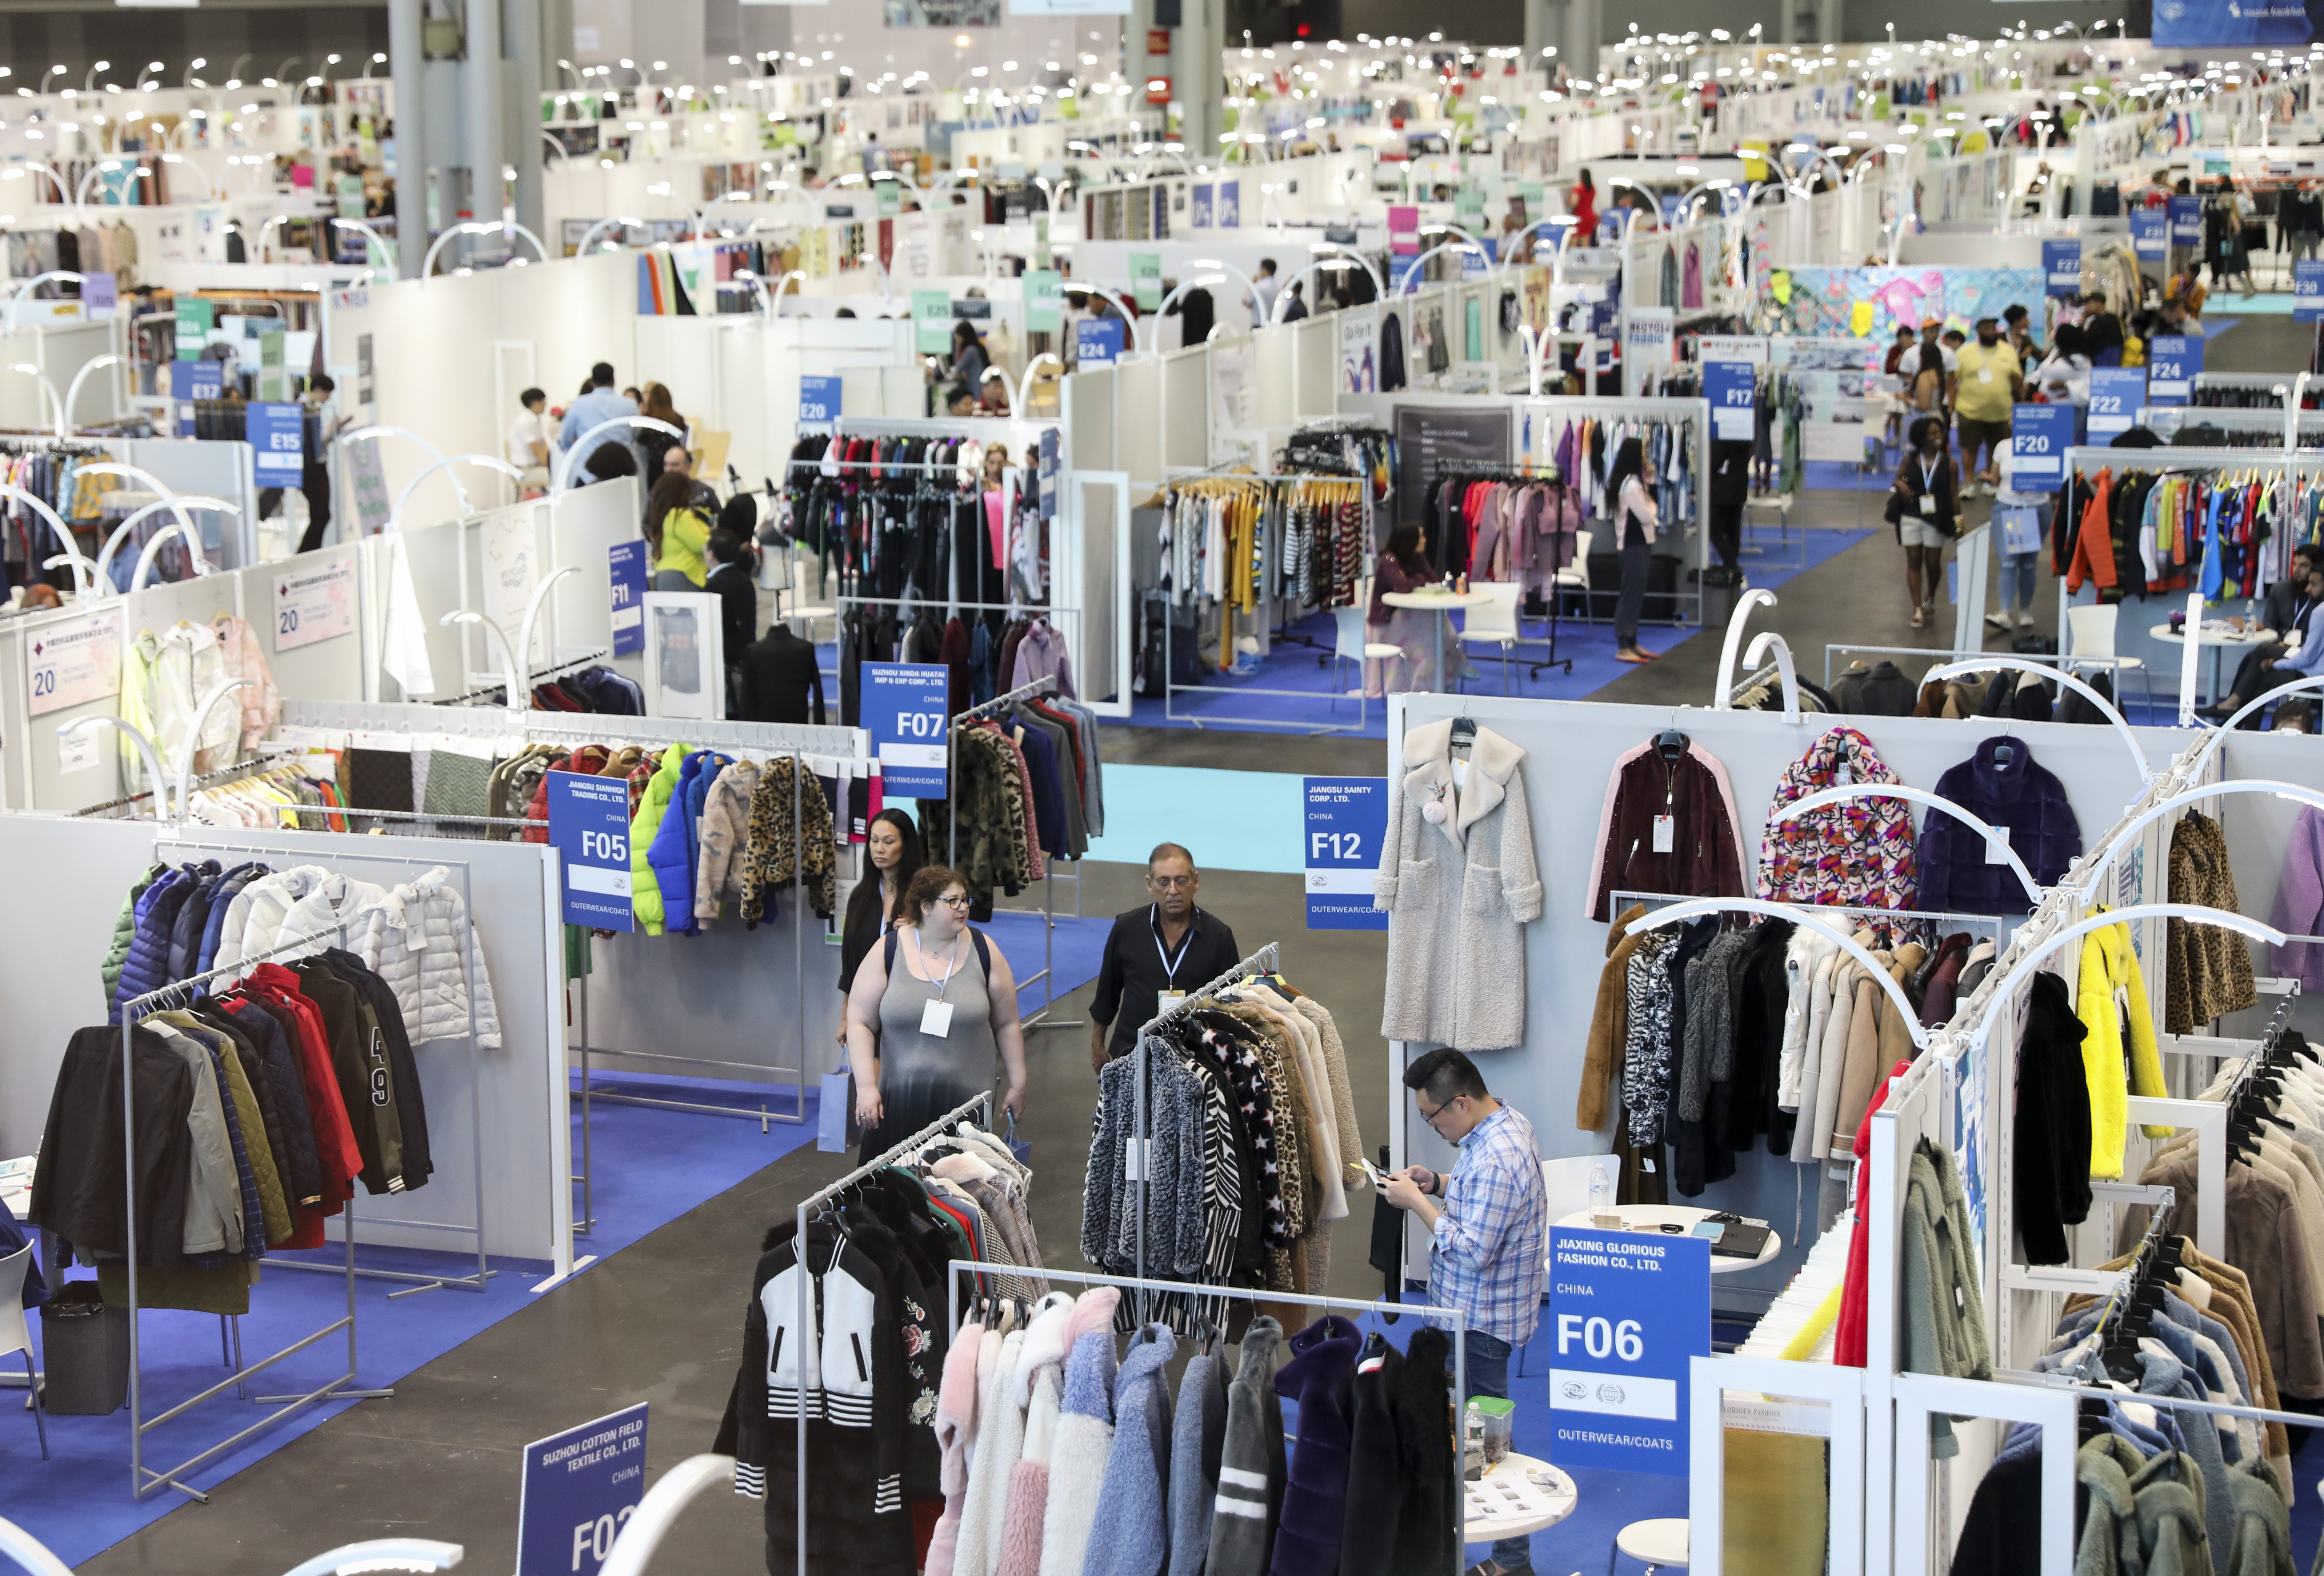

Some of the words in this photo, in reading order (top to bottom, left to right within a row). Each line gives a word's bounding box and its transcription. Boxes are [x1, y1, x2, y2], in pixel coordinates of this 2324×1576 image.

[2244, 8, 2269, 17] messe
[2271, 6, 2306, 17] frankfurt
[332, 291, 369, 308] KOREA
[1079, 343, 1105, 357] E24
[2152, 362, 2181, 379] F24
[192, 383, 221, 399] E17
[1727, 389, 1752, 405] F17
[800, 403, 826, 419] E20
[2090, 396, 2121, 413] F22
[270, 432, 301, 450] E15
[2015, 435, 2050, 453] F20
[612, 583, 629, 605] F11
[280, 610, 298, 634] 20
[35, 670, 54, 696] 20
[897, 712, 944, 737] F07
[568, 781, 595, 790] JIANGSU
[596, 784, 625, 794] SIANHIGH
[571, 790, 598, 799] TRADING
[599, 794, 610, 802] CO.,
[606, 814, 626, 822] CHINA
[582, 830, 626, 862] F05
[1312, 833, 1361, 859] F12
[570, 902, 629, 916] OUTERWEAR/COATS
[1557, 1239, 1603, 1251] JIAXING
[1606, 1243, 1665, 1257] GLORIOUS
[1557, 1253, 1607, 1266] FASHION
[1611, 1257, 1634, 1270] CO.,
[1637, 1259, 1661, 1271] LTD.
[1557, 1284, 1594, 1296] CHINA
[1558, 1314, 1643, 1360] F06
[1754, 1409, 1780, 1417] FASHION
[543, 1442, 580, 1465] SUZHOU
[581, 1429, 616, 1451] COTTON
[618, 1420, 643, 1437] FIELD
[1558, 1429, 1673, 1449] OUTERWEAR/COATS
[568, 1449, 601, 1472] TEXTILE
[603, 1445, 619, 1458] CO.,
[623, 1436, 640, 1451] LTD.
[612, 1465, 640, 1483] CHINA
